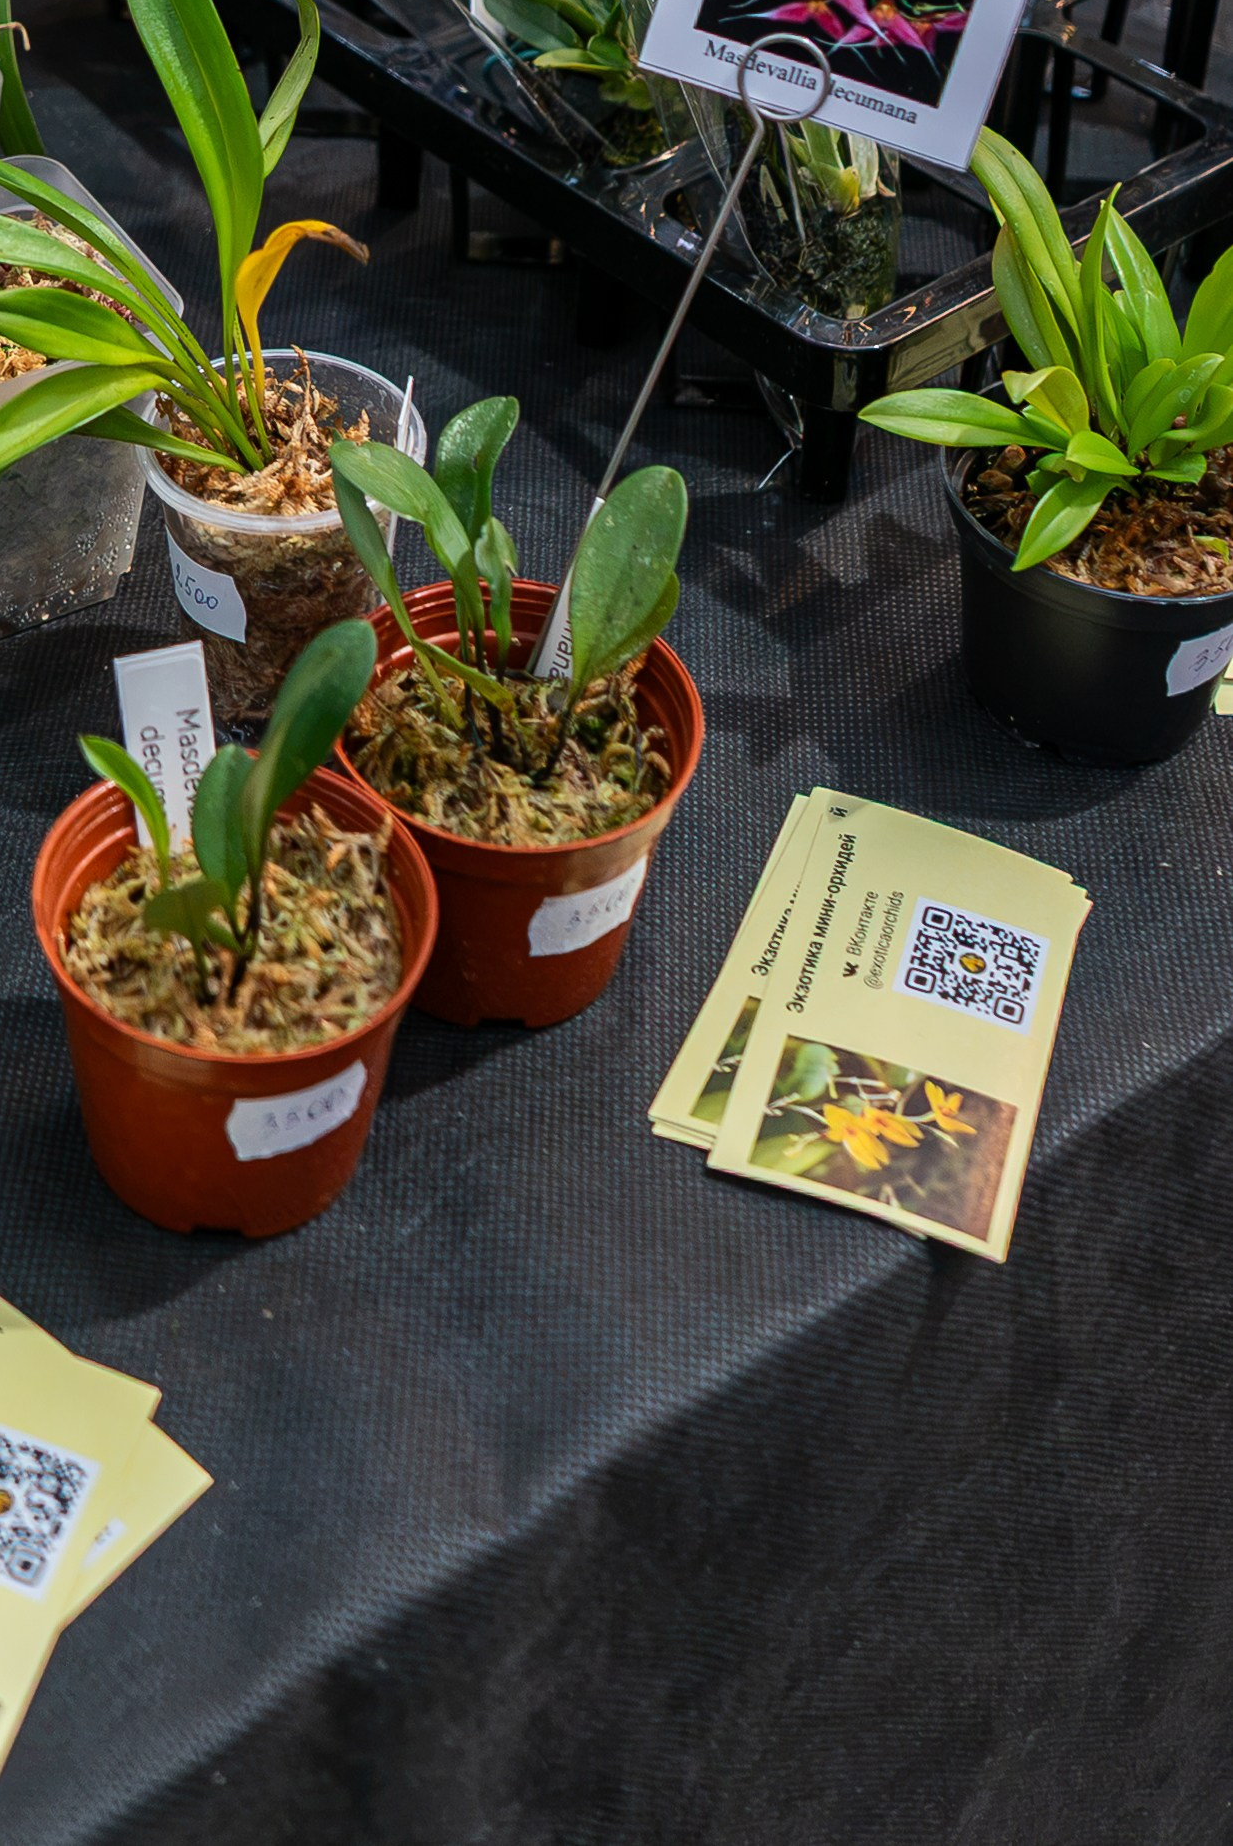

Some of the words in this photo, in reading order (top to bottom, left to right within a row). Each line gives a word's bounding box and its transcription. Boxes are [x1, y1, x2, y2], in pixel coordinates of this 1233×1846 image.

[704, 40, 817, 91] Masdevallia
[786, 941, 824, 1014] Экзотика
[813, 833, 857, 939] мини-орхидей
[846, 890, 879, 956] ВКонтакте
[863, 890, 905, 990] @exoticaorchids
